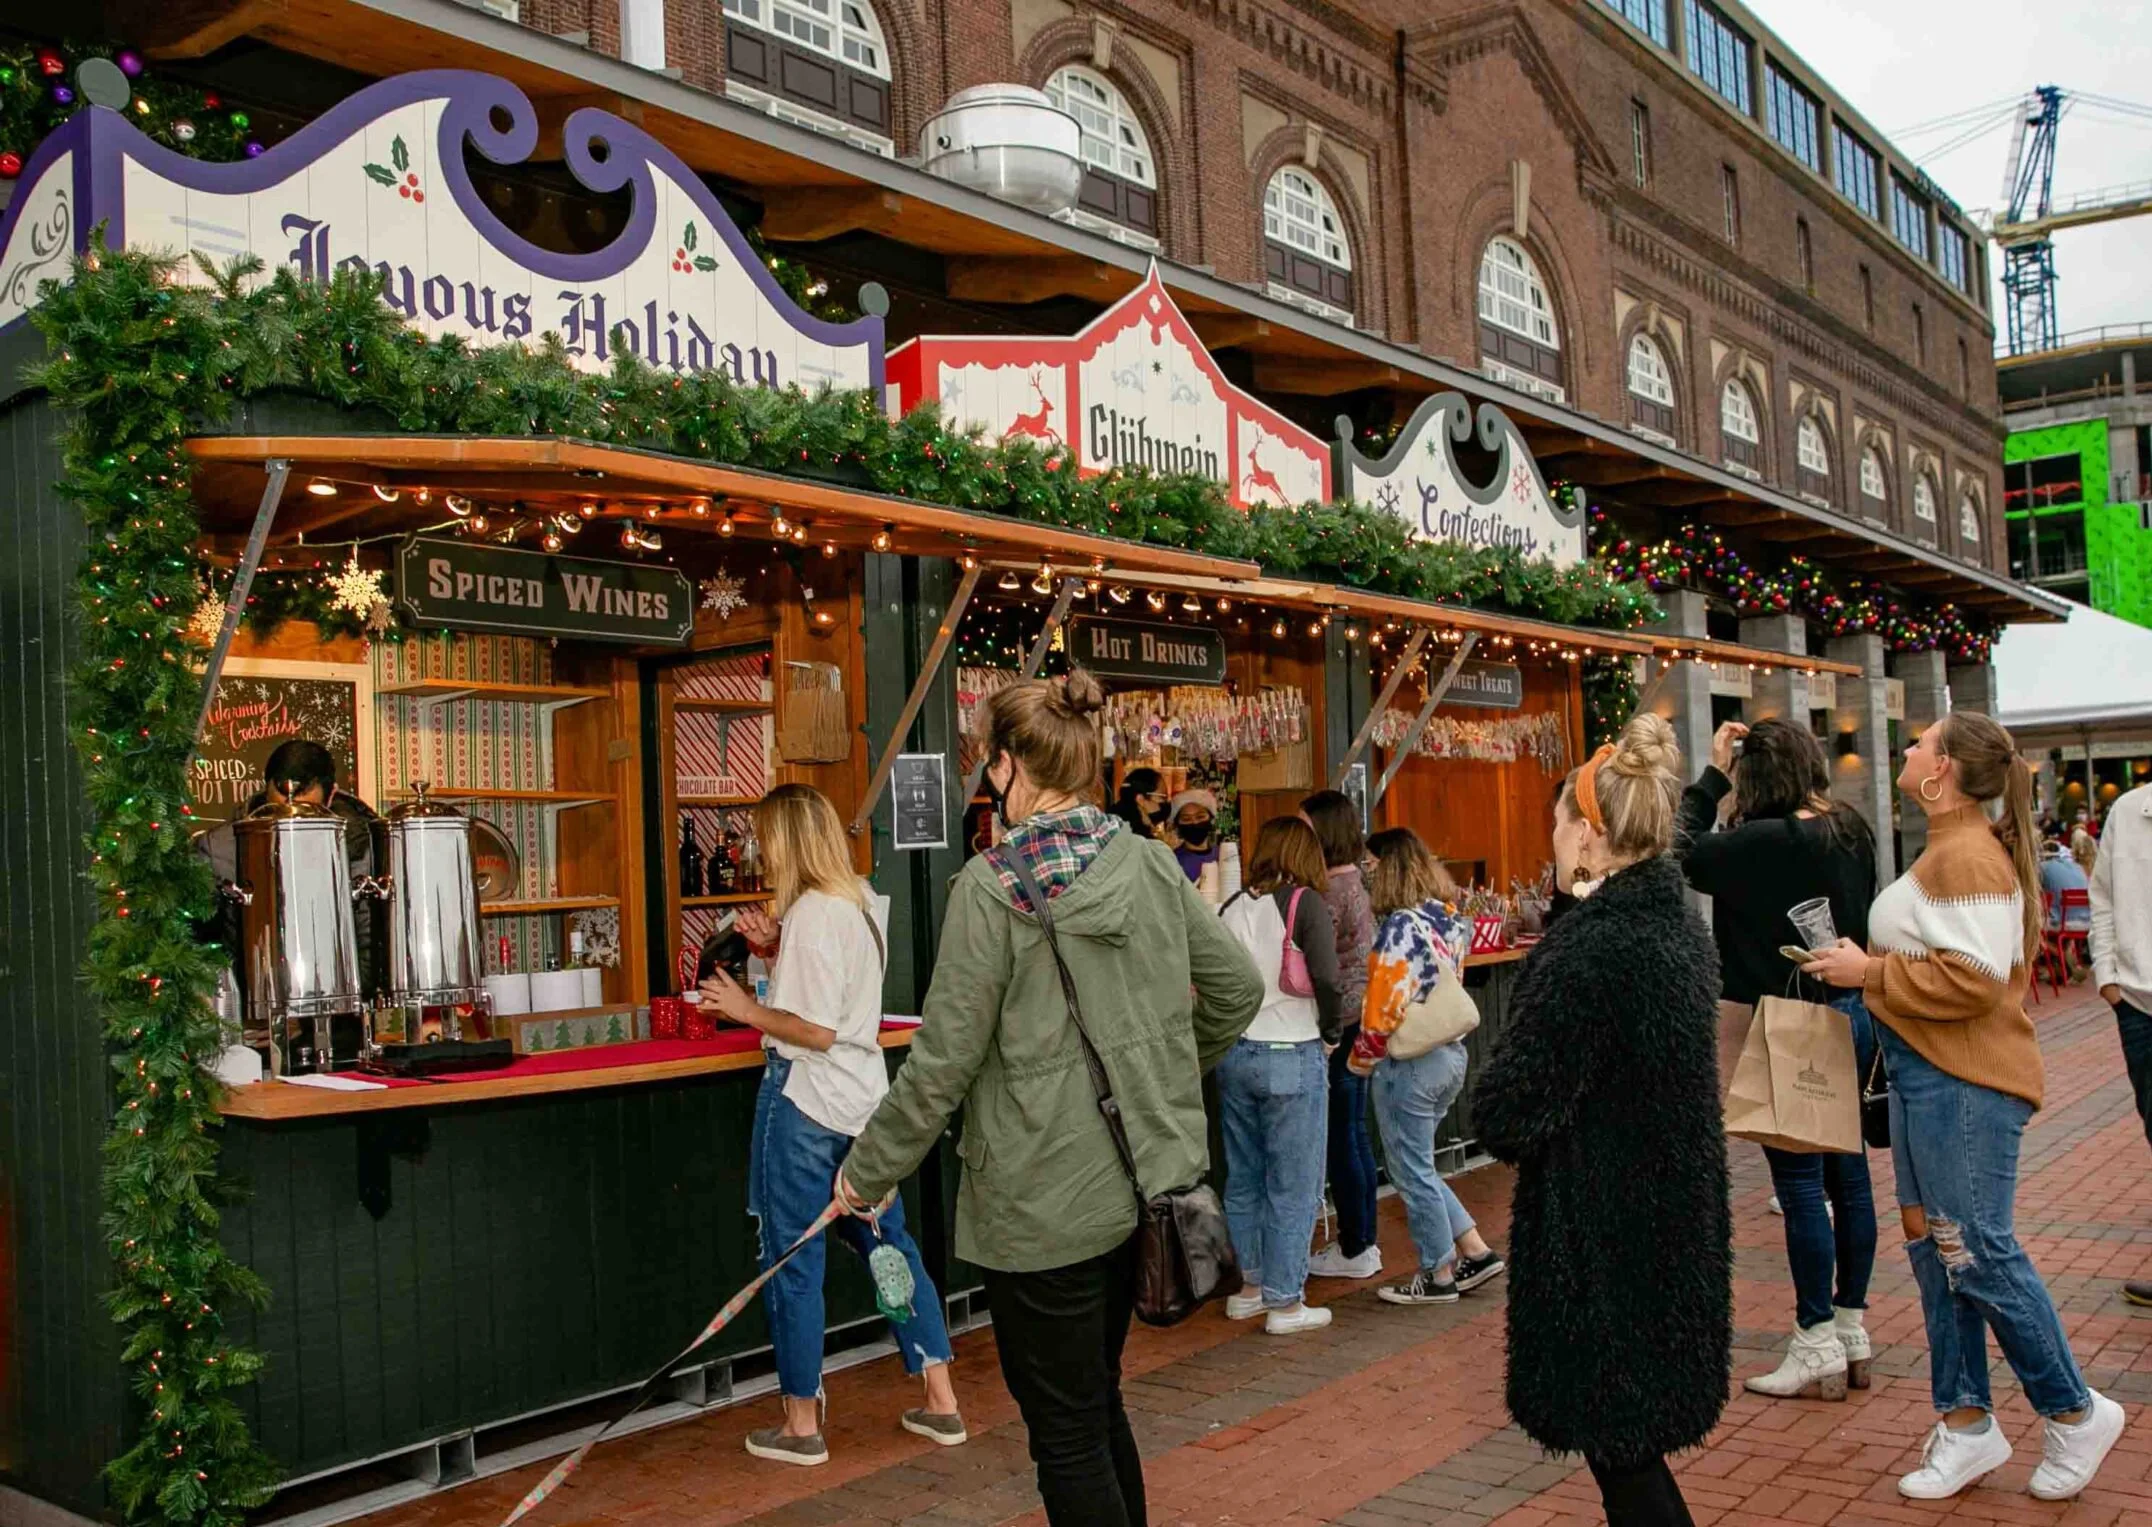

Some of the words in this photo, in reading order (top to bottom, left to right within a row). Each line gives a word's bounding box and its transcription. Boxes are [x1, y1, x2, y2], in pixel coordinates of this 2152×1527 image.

[557, 290, 780, 393] Holiday
[1090, 403, 1218, 481] Glühwein
[1416, 475, 1538, 555] Confections
[1446, 669, 1478, 691] WEET
[230, 706, 302, 750] Cocktails
[195, 758, 247, 780] SPICED
[678, 779, 717, 795] HOCOLATE
[718, 779, 734, 795] BAR
